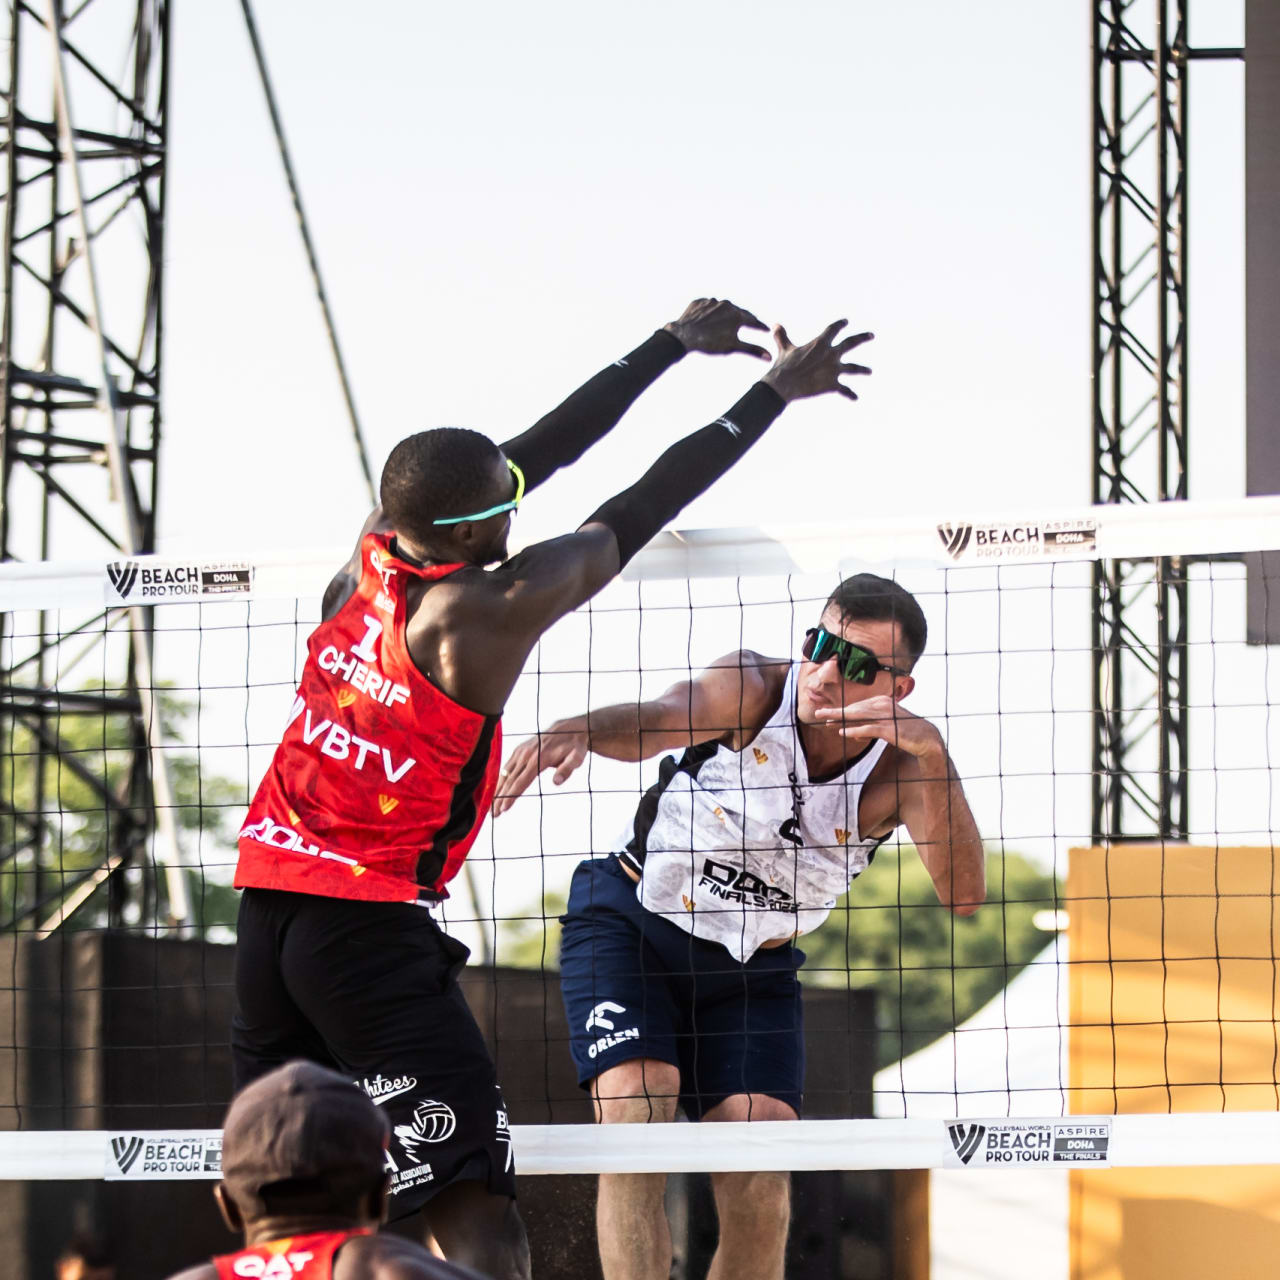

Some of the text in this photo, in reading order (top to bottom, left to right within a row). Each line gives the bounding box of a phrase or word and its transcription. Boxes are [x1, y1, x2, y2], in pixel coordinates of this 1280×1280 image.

[976, 527, 1039, 546] BEACH
[141, 567, 199, 584] BEACH
[142, 584, 199, 597] PRO TOUR
[350, 614, 383, 663] 1
[318, 646, 411, 708] CHERIF
[302, 709, 417, 784] VBTV
[699, 876, 766, 908] FINALS
[588, 1027, 640, 1058] ORLEN
[987, 1132, 1051, 1149] BEACH
[1067, 1140, 1095, 1150] DOHA
[145, 1145, 203, 1160] BEACH
[986, 1150, 1049, 1162] PRO TOUR
[143, 1162, 167, 1172] PRO
[170, 1161, 201, 1172] TOUR
